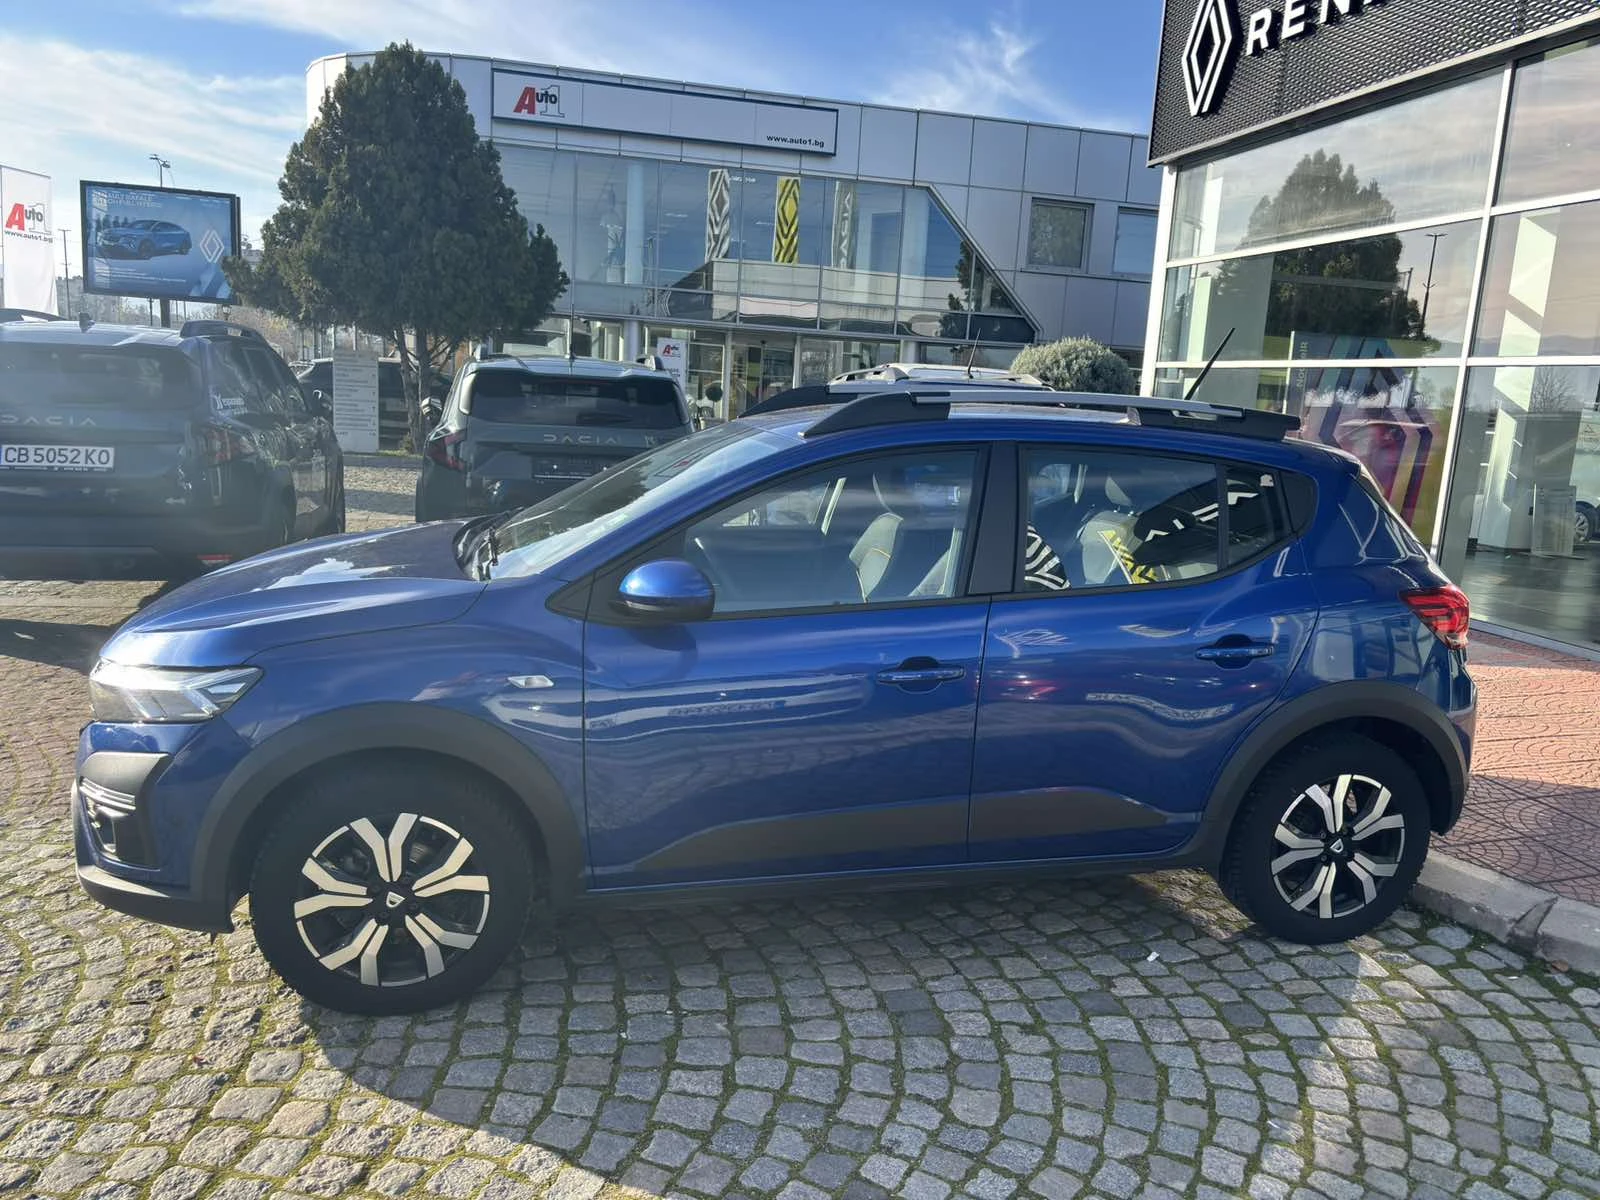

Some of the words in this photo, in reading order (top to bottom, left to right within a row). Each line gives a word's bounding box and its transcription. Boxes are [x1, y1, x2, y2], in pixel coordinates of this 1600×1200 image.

[1246, 0, 1373, 56] REN
[766, 135, 825, 149] www.auto1.bg
[1, 414, 97, 427] DACIA
[543, 433, 618, 445] DACIA
